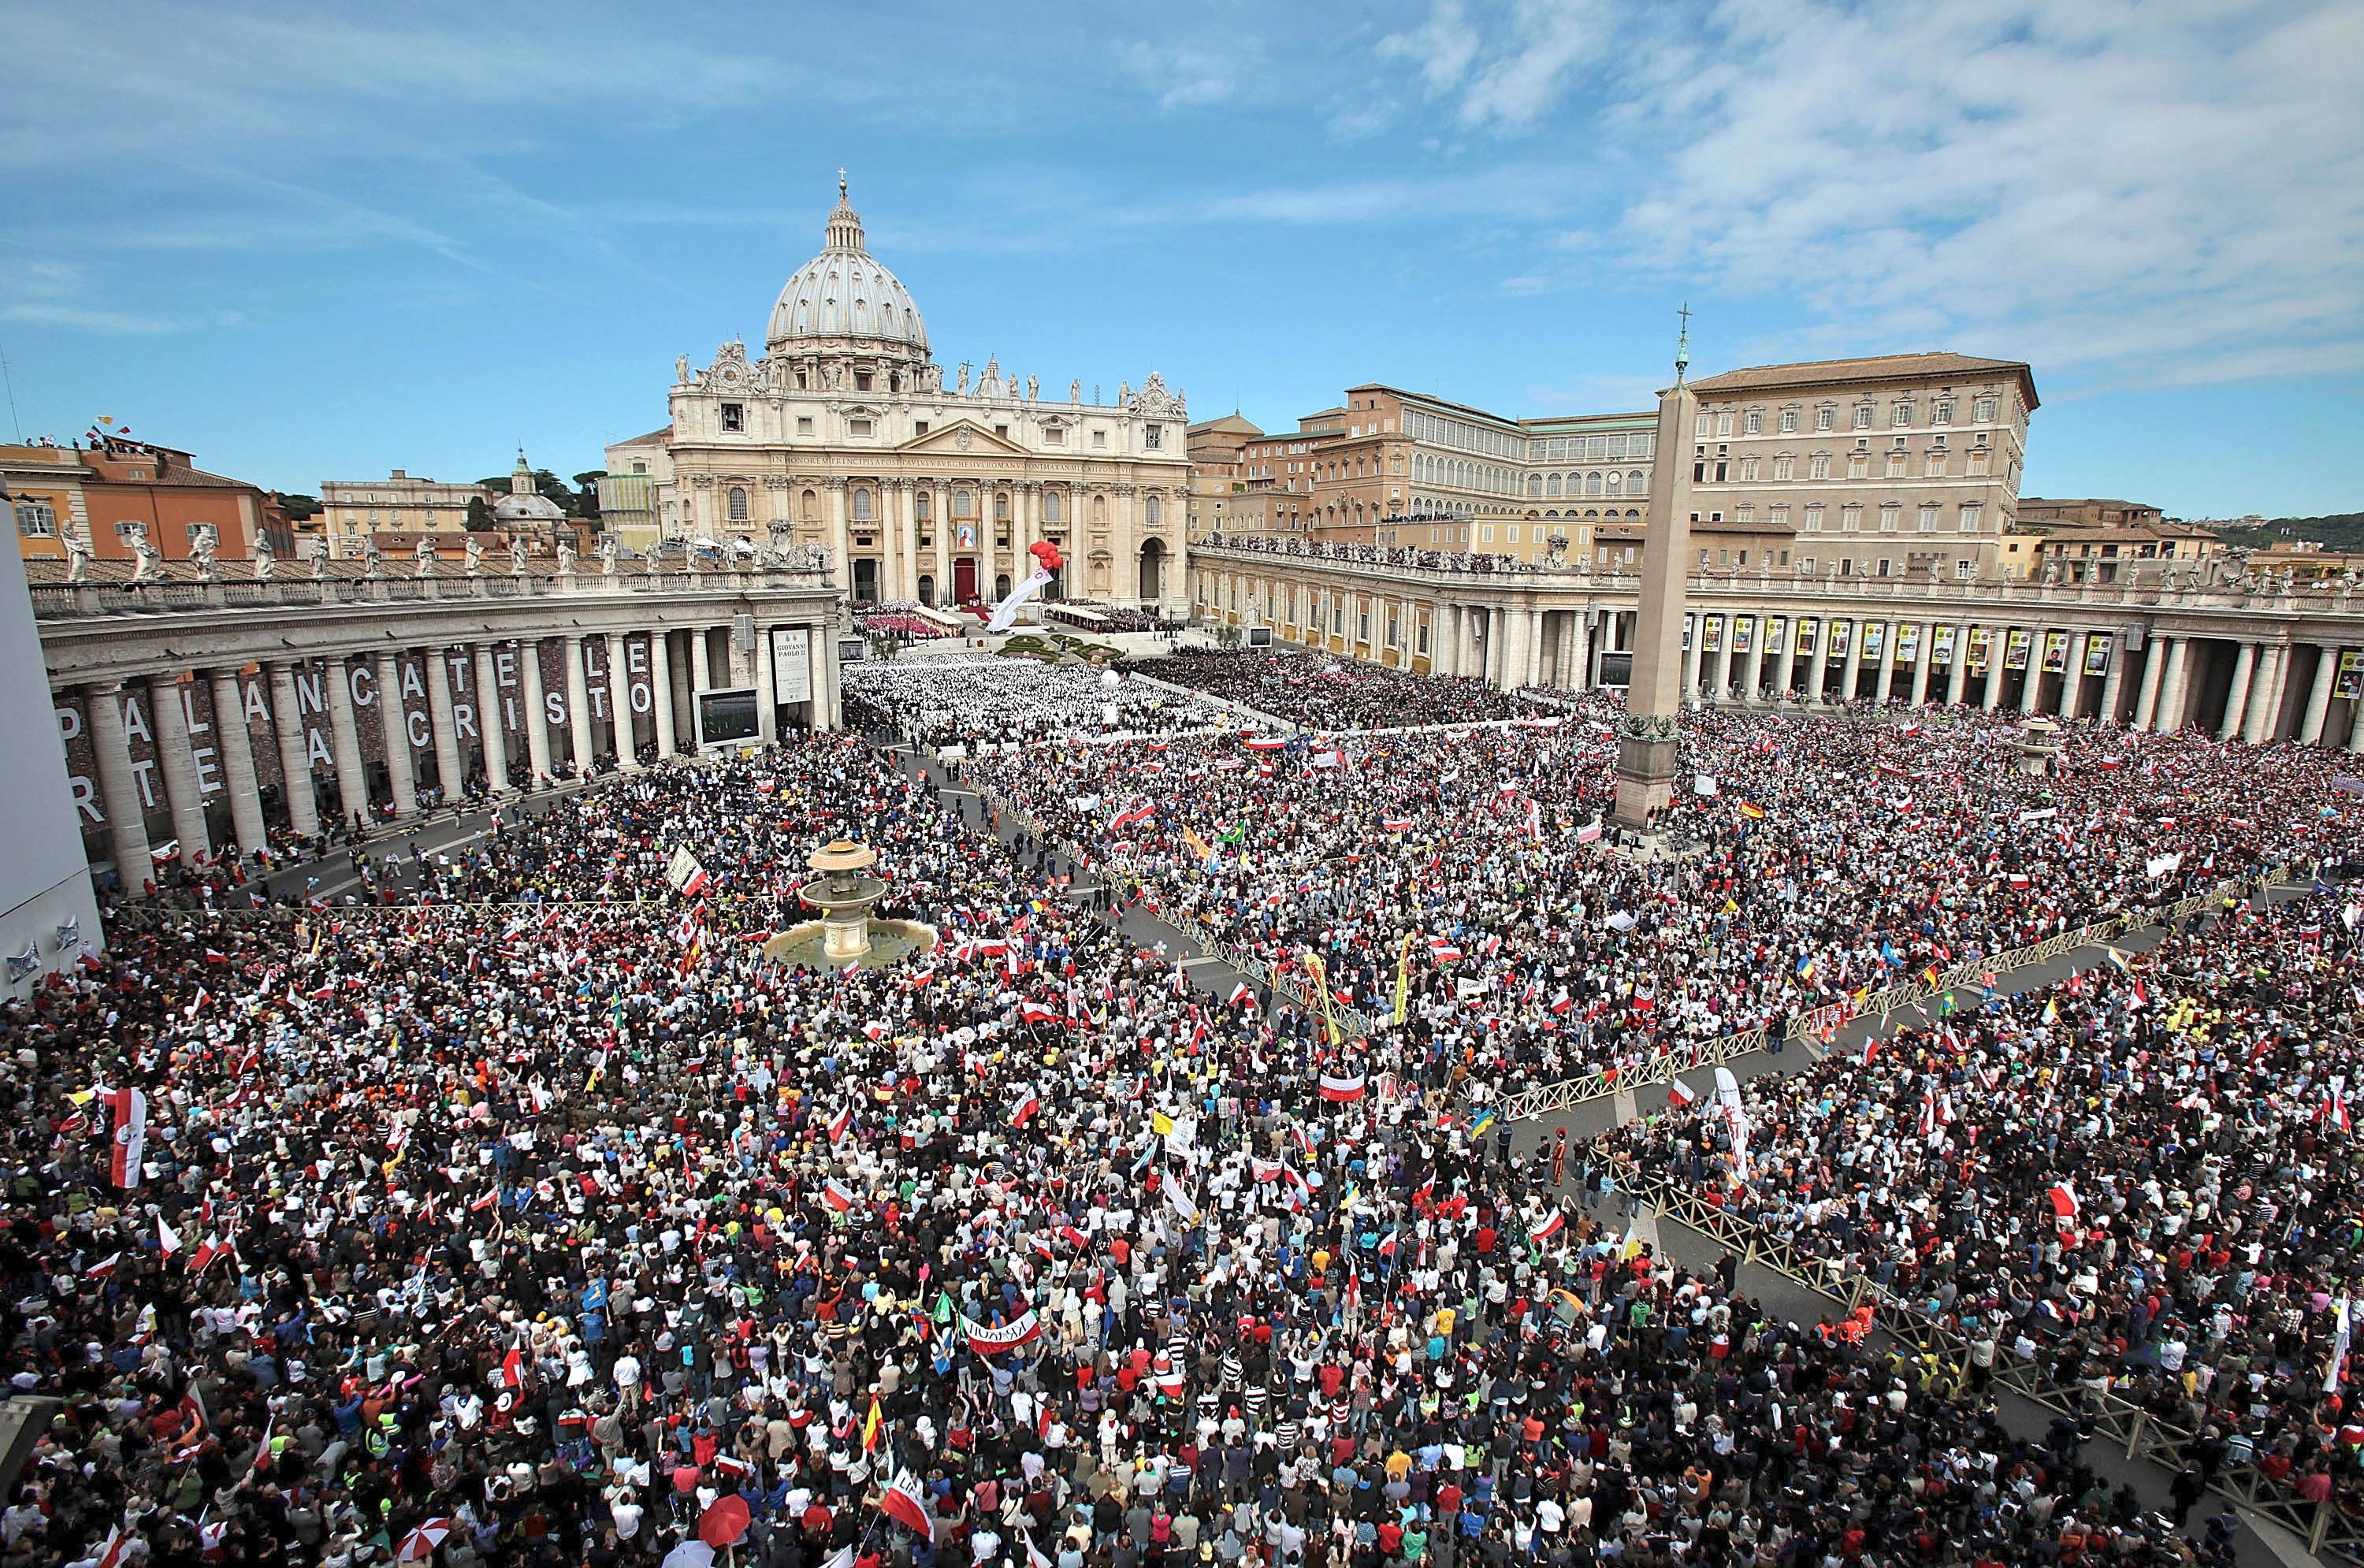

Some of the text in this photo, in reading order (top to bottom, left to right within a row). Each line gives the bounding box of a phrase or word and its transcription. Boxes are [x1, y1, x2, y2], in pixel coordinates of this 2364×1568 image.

[786, 455, 828, 464] HONOREM
[831, 457, 874, 466] PRINCIPIS
[776, 643, 806, 652] GIOVANNI
[587, 643, 646, 678] LE
[308, 728, 333, 769] A
[407, 682, 652, 748] CRISTO
